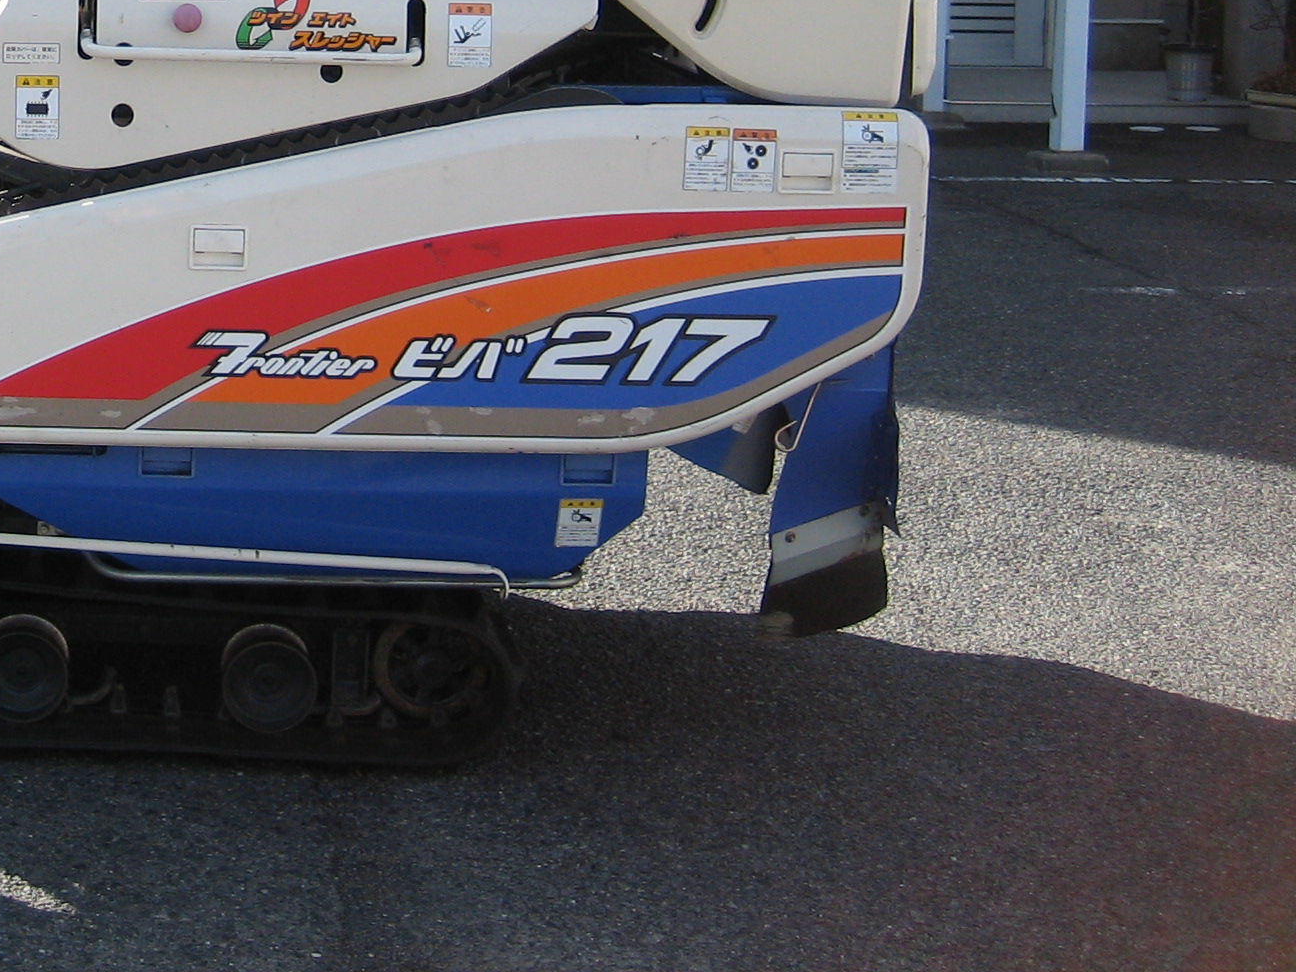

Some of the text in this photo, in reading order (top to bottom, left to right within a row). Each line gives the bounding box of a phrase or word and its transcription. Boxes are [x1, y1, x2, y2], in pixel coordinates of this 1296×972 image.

[307, 11, 357, 28] エイト
[288, 30, 398, 52] スレッシャー
[195, 331, 378, 378] Frontier
